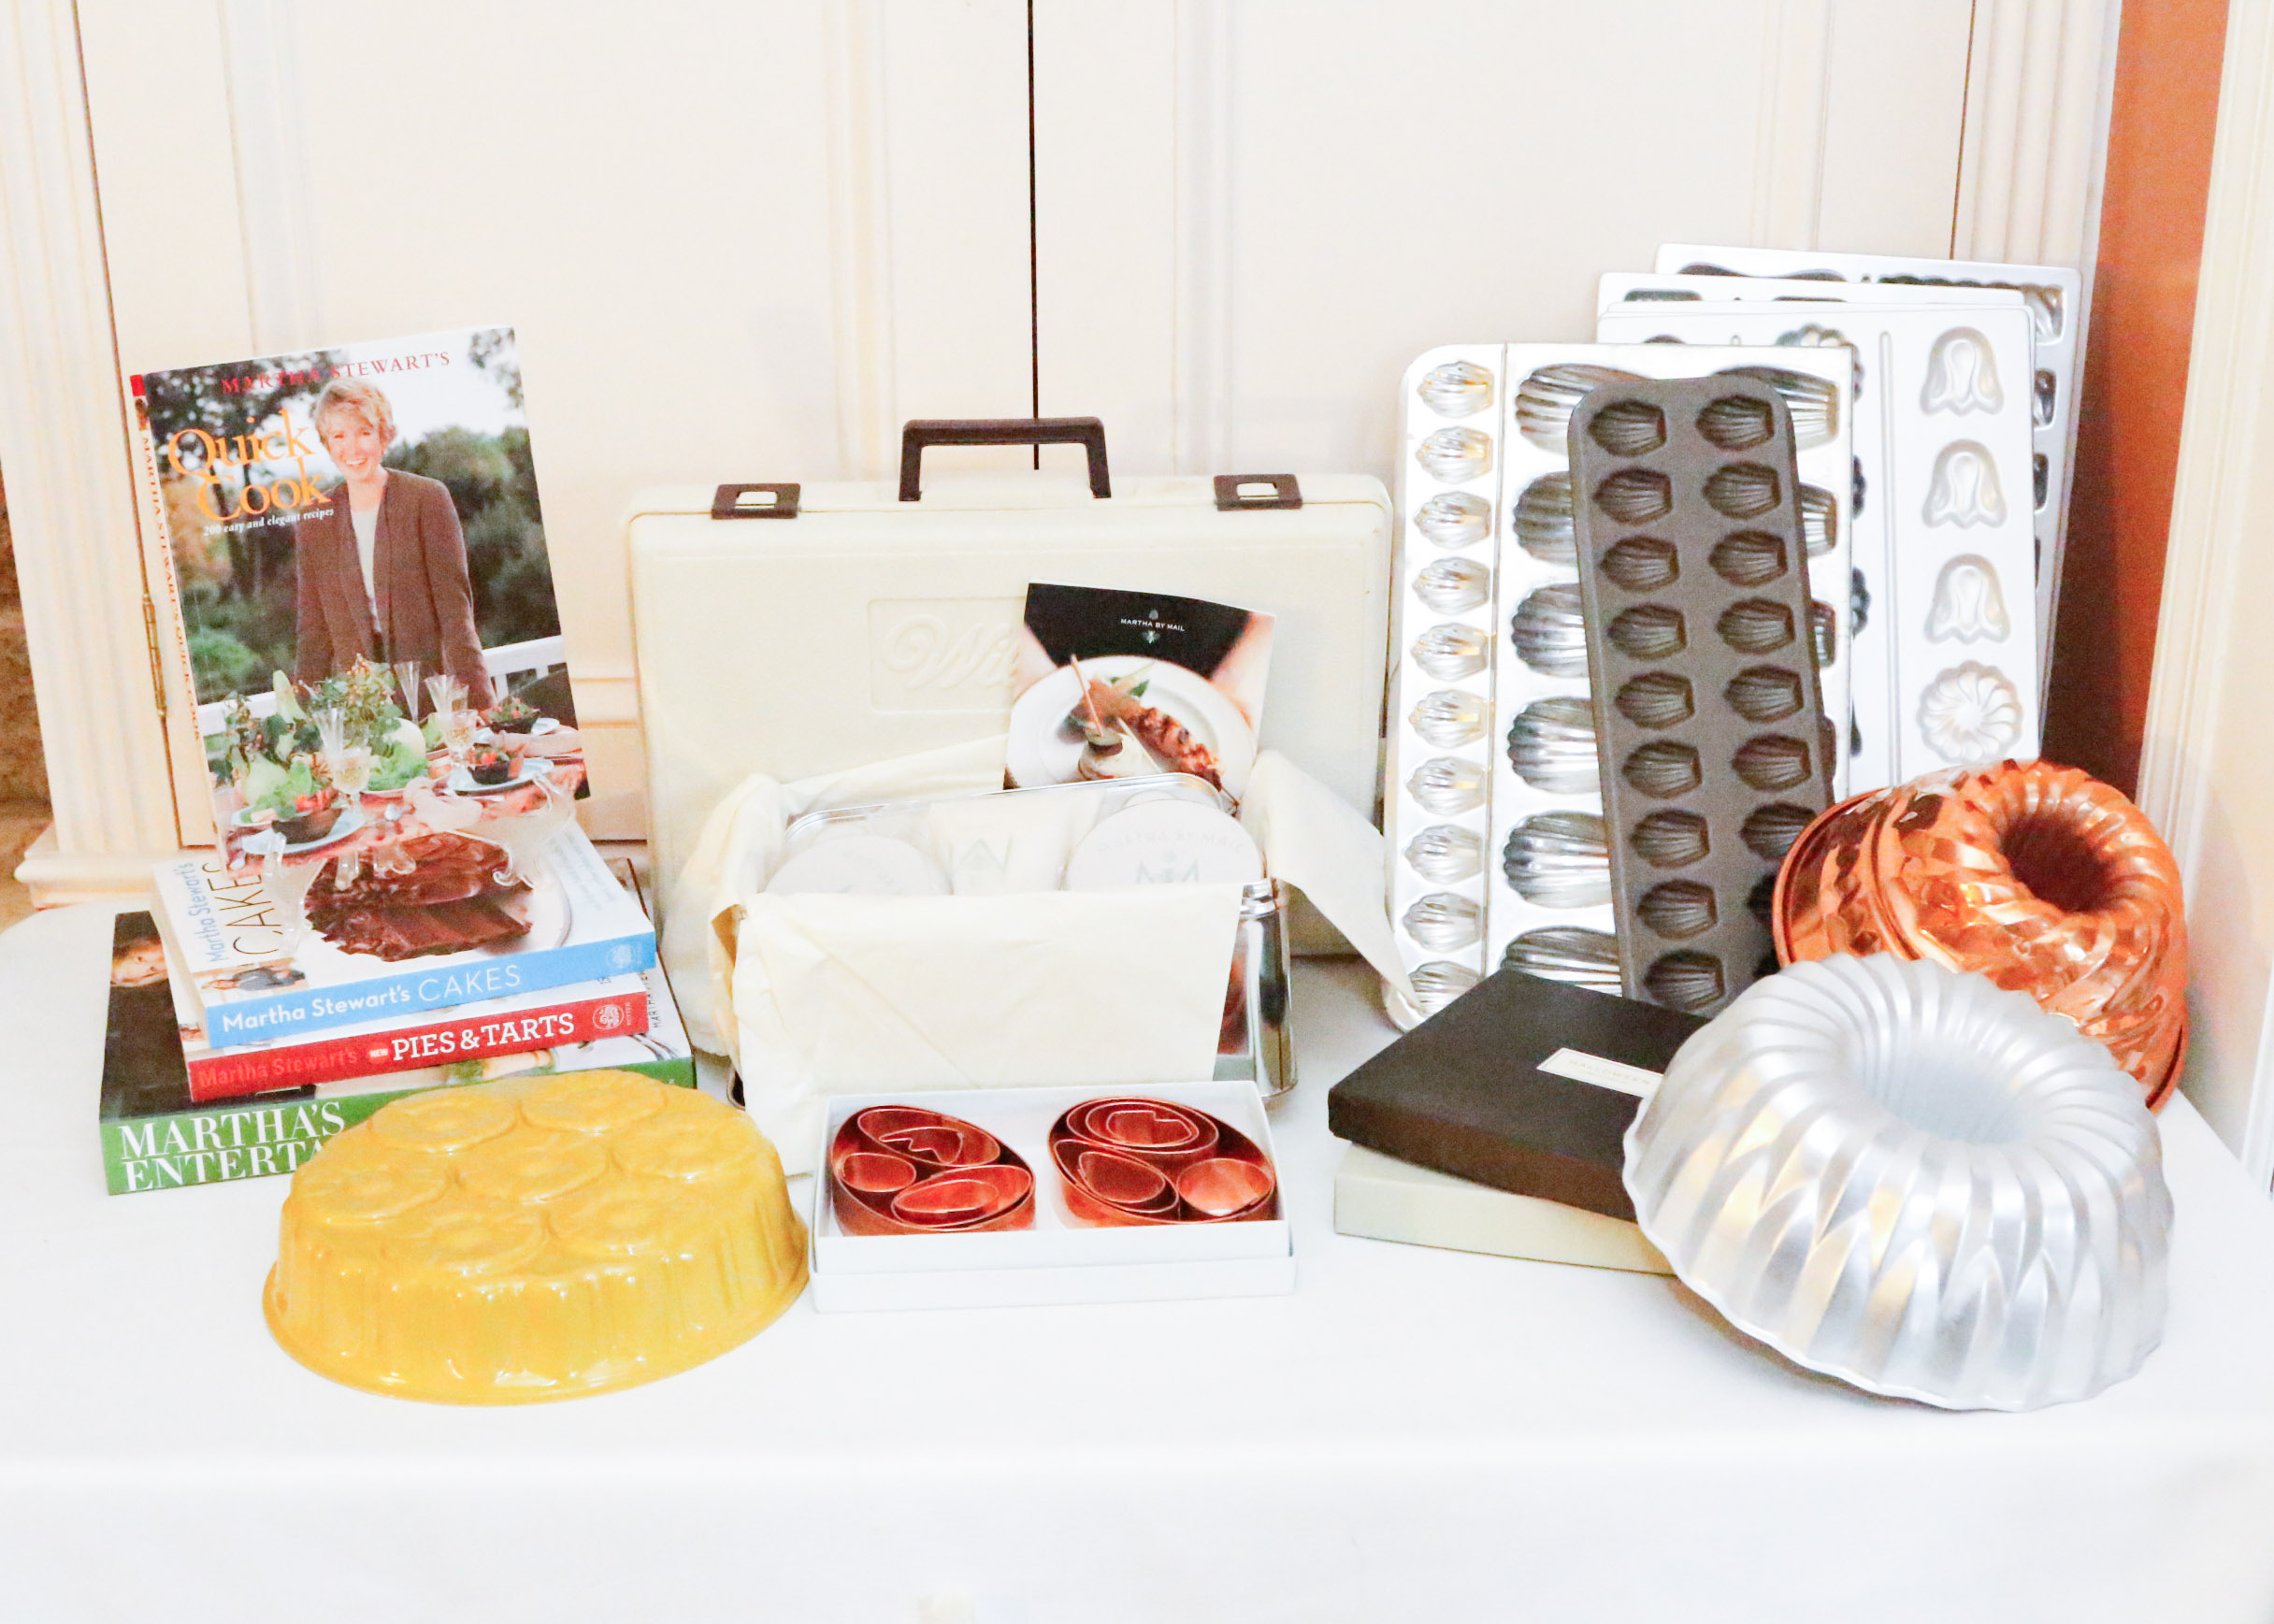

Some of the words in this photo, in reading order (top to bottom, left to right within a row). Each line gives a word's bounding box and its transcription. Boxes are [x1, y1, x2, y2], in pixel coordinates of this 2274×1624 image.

[222, 368, 321, 395] MARTHA
[331, 351, 451, 380] STEWART'S
[167, 407, 316, 479] Quick
[197, 457, 333, 522] Cook
[203, 525, 222, 537] 200
[223, 522, 245, 537] easy
[247, 518, 265, 531] and
[266, 512, 301, 530] elegant
[303, 508, 335, 524] recipes
[1120, 618, 1153, 627] MARTHA
[1167, 624, 1186, 632] MAIL
[172, 862, 211, 918] Stewart's
[194, 916, 230, 962] Martha
[223, 1000, 307, 1033] Martha
[311, 984, 411, 1018] Stewart's
[418, 964, 521, 1002] CAKES
[197, 1058, 269, 1087] Martha
[272, 1045, 358, 1077] Stewart's
[369, 1047, 389, 1059] NEW
[392, 1030, 455, 1061] PIES
[460, 1028, 481, 1049] &
[480, 1012, 575, 1048] TARTS
[117, 1101, 345, 1160] MARTHA'S
